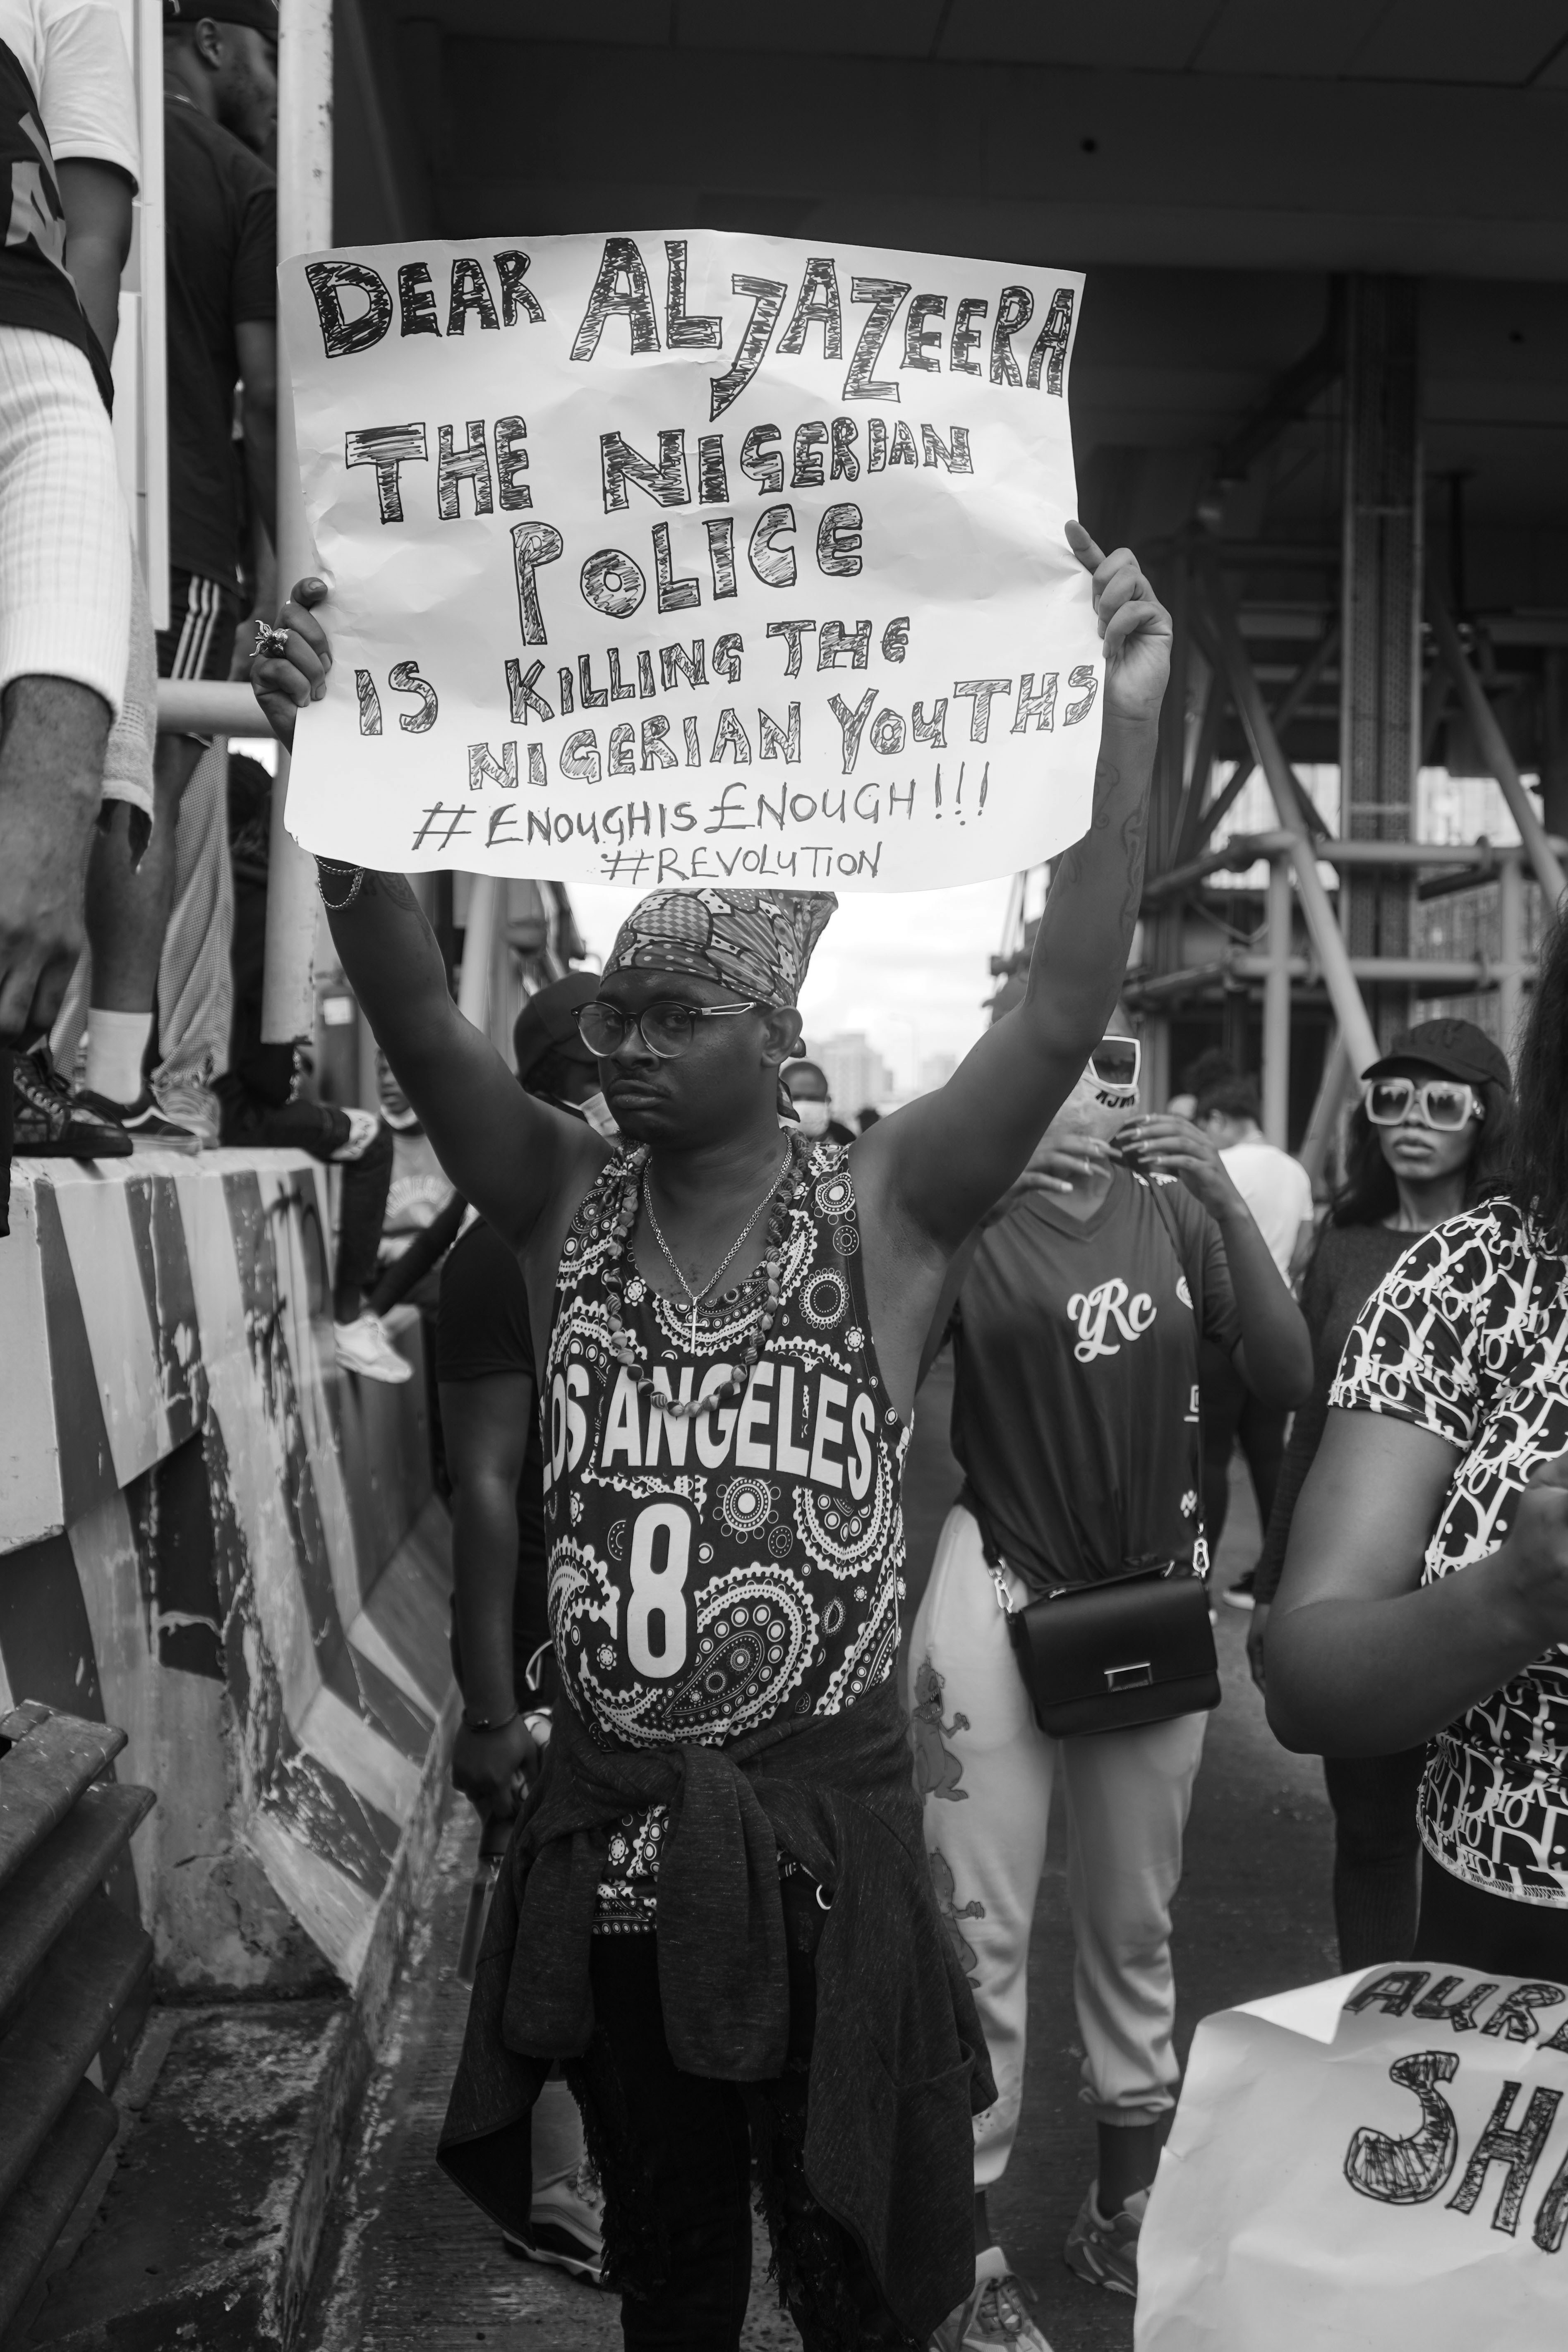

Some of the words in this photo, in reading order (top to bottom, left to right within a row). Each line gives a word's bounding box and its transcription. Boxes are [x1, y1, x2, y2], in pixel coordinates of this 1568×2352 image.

[305, 250, 547, 358] DEAR
[345, 415, 533, 524] THE
[600, 416, 973, 513] NIGERIAN
[510, 502, 863, 646] POLICE
[354, 661, 438, 736] IS
[505, 633, 744, 726] KILLING
[766, 616, 911, 679] THE
[468, 701, 802, 791] NIGERIAN
[827, 664, 1098, 774] YOUTHS
[600, 840, 883, 885] #REVOLUTION
[601, 1361, 875, 1500] ANGELES
[626, 1502, 692, 1679] 8
[1344, 1971, 1568, 2052] AUR
